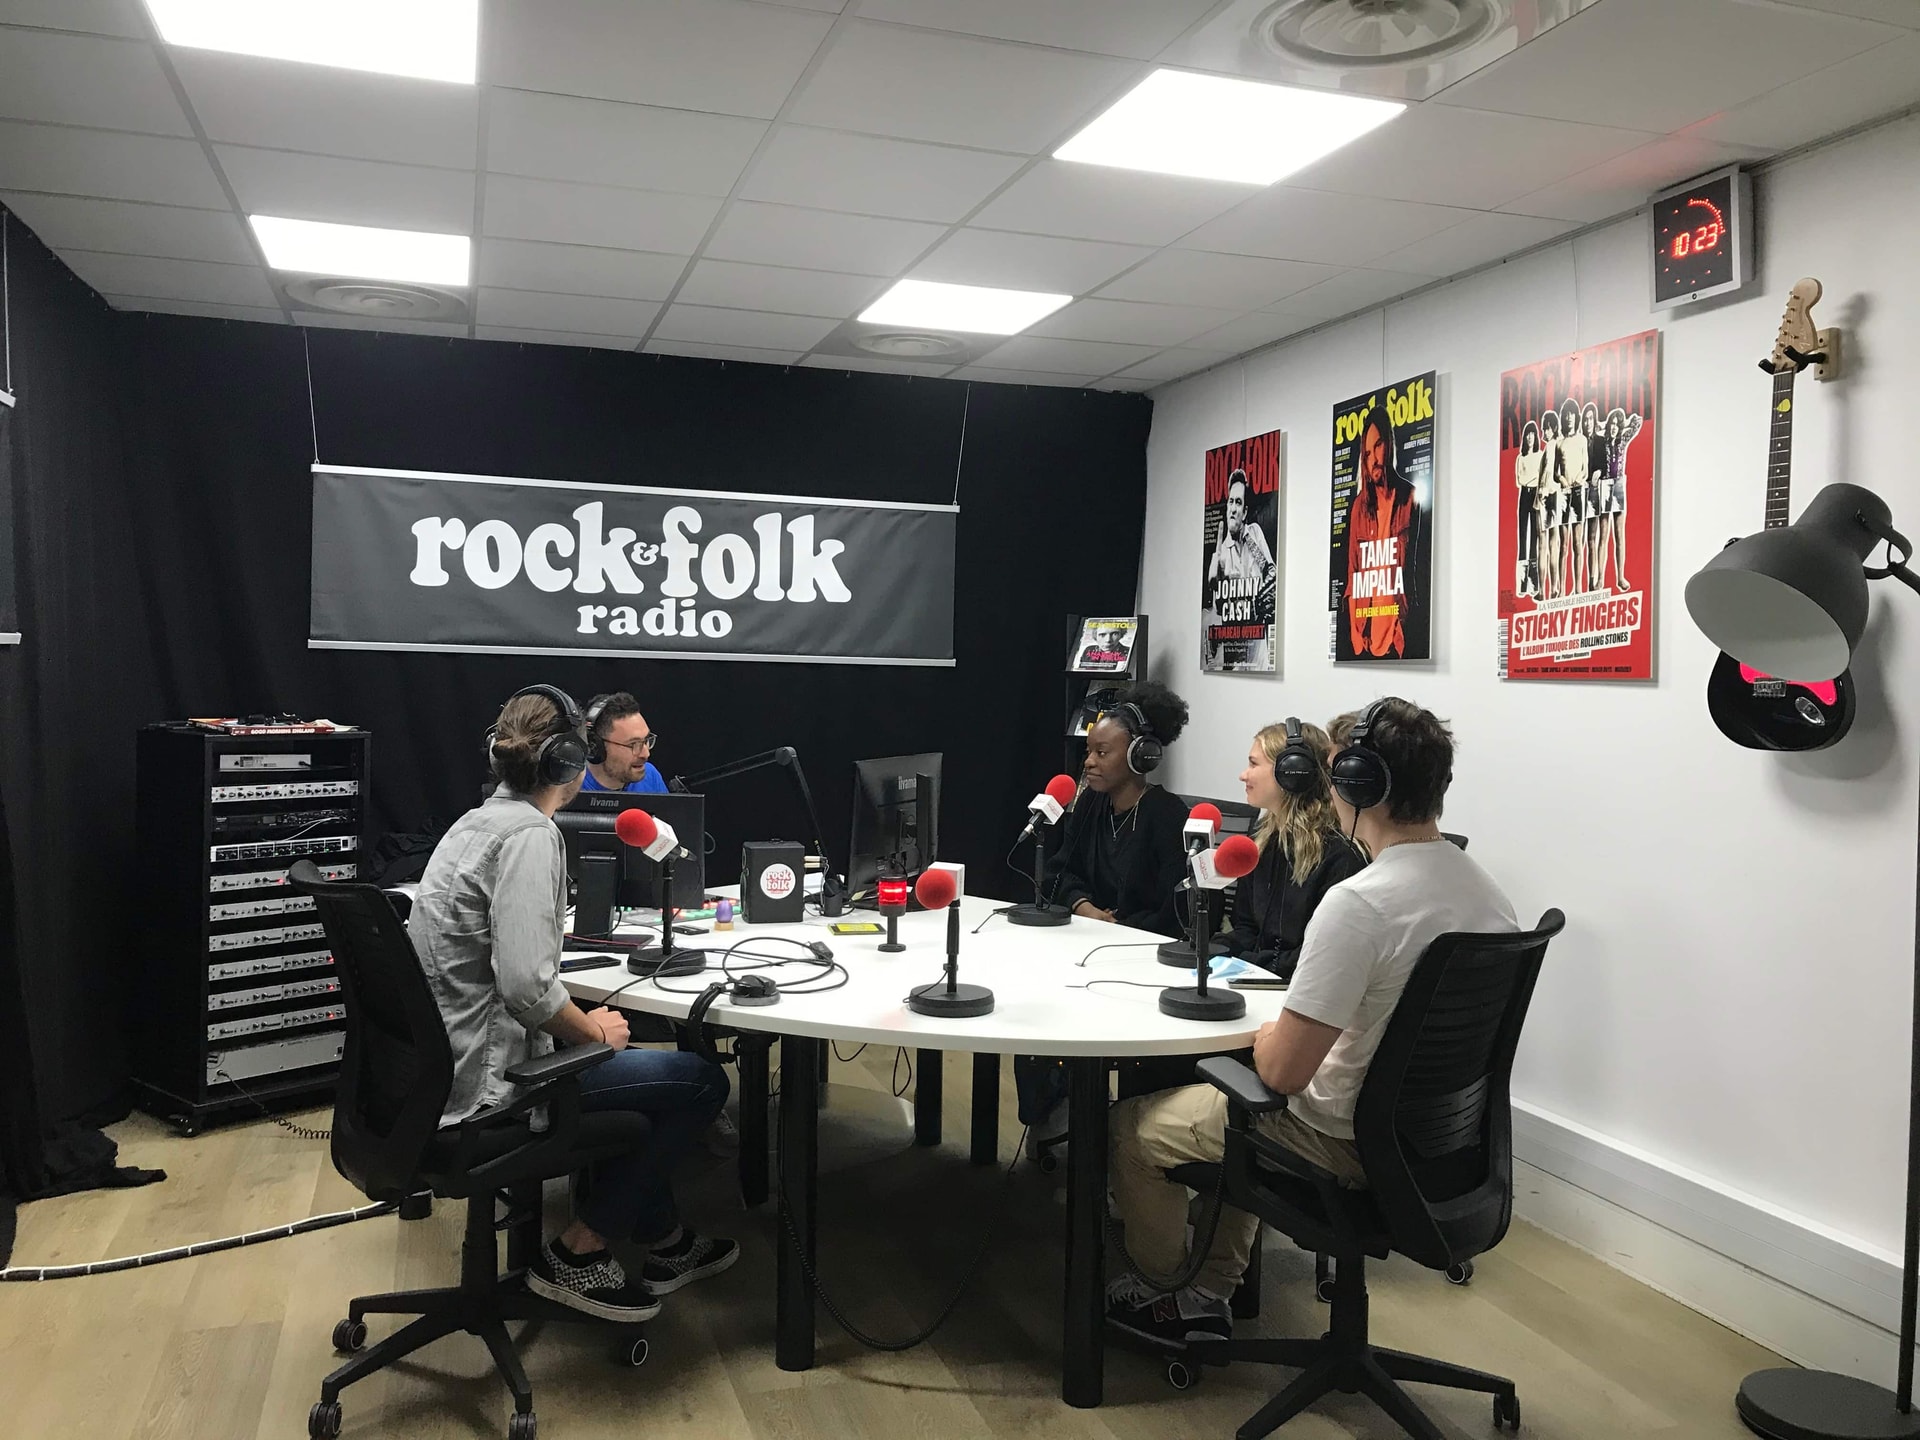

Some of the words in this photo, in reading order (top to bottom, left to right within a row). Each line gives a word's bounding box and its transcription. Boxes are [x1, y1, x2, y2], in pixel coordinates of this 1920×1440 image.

[1359, 537, 1399, 569] TAME
[1215, 577, 1260, 600] JOHNNY
[1352, 567, 1404, 599] IMPALA
[576, 598, 734, 639] radio
[1222, 601, 1251, 622] CASH
[1514, 609, 1569, 644] STICKY
[1571, 597, 1639, 634] FINGERS
[1569, 639, 1580, 650] DES
[1580, 634, 1604, 648] ROLLING
[1604, 631, 1629, 645] STONES
[590, 796, 619, 807] iiyama
[766, 869, 791, 881] rock
[767, 879, 790, 891] folk
